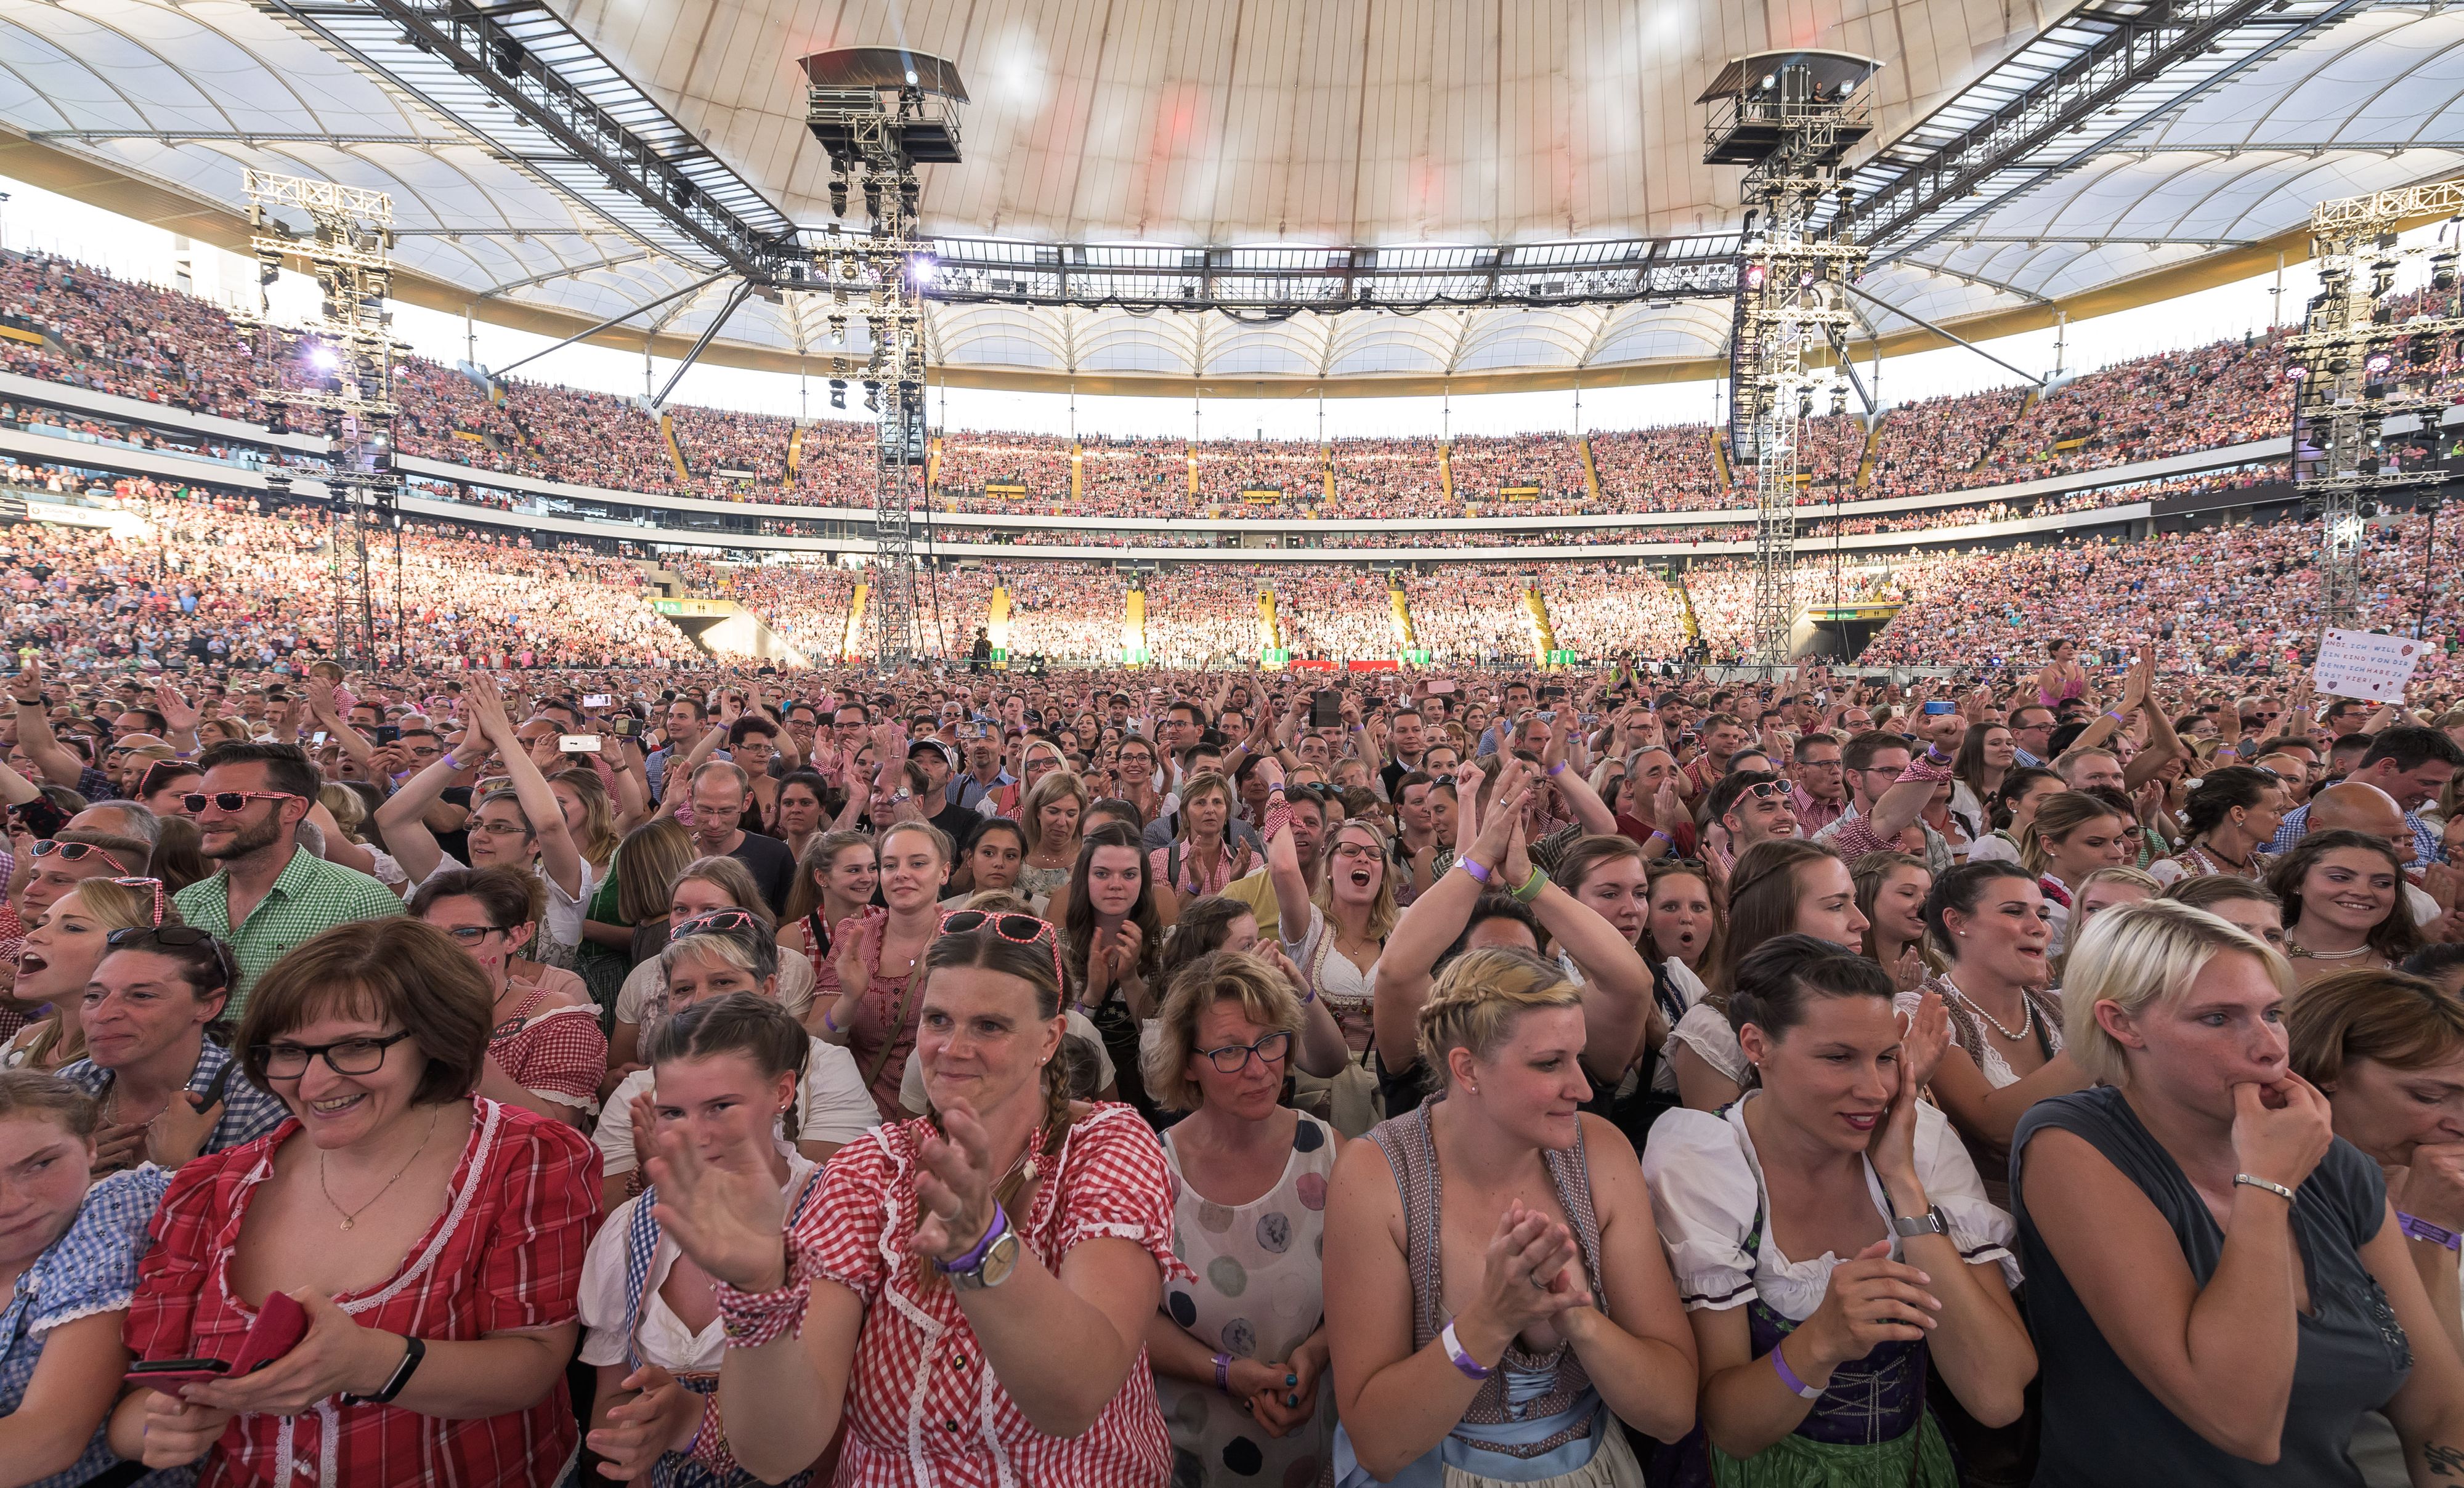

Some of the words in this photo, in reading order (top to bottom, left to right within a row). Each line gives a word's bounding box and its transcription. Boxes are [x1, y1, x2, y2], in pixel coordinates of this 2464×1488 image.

[2374, 645, 2396, 653] WILL
[2320, 661, 2346, 669] DENN
[2366, 668, 2391, 676] HABE
[2346, 675, 2372, 684] VIER!
